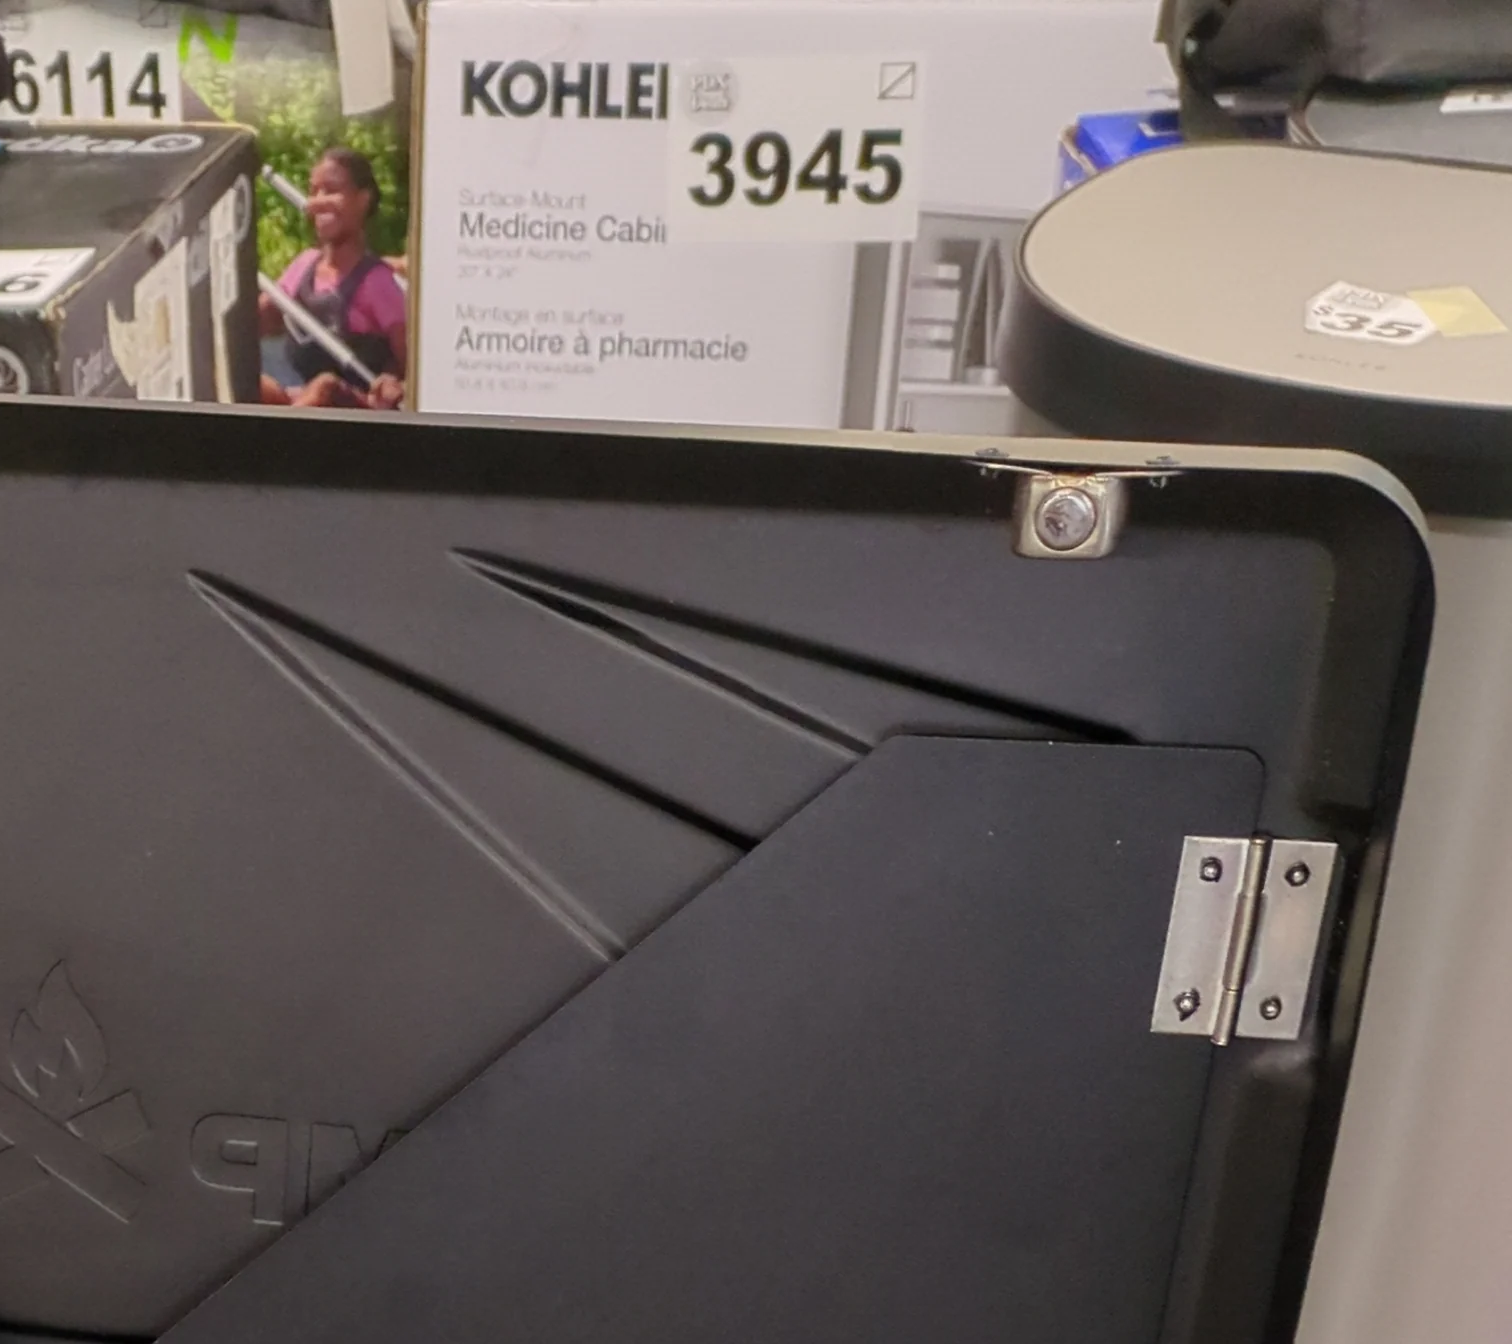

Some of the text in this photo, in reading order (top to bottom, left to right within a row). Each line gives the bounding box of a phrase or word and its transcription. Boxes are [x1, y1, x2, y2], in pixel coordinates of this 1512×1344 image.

[6, 48, 167, 121] 6114
[461, 61, 669, 120] KOHLE
[687, 128, 904, 208] 3945
[458, 210, 667, 245] Medicine Cabi
[455, 325, 749, 363] Armoire à pharmacie
